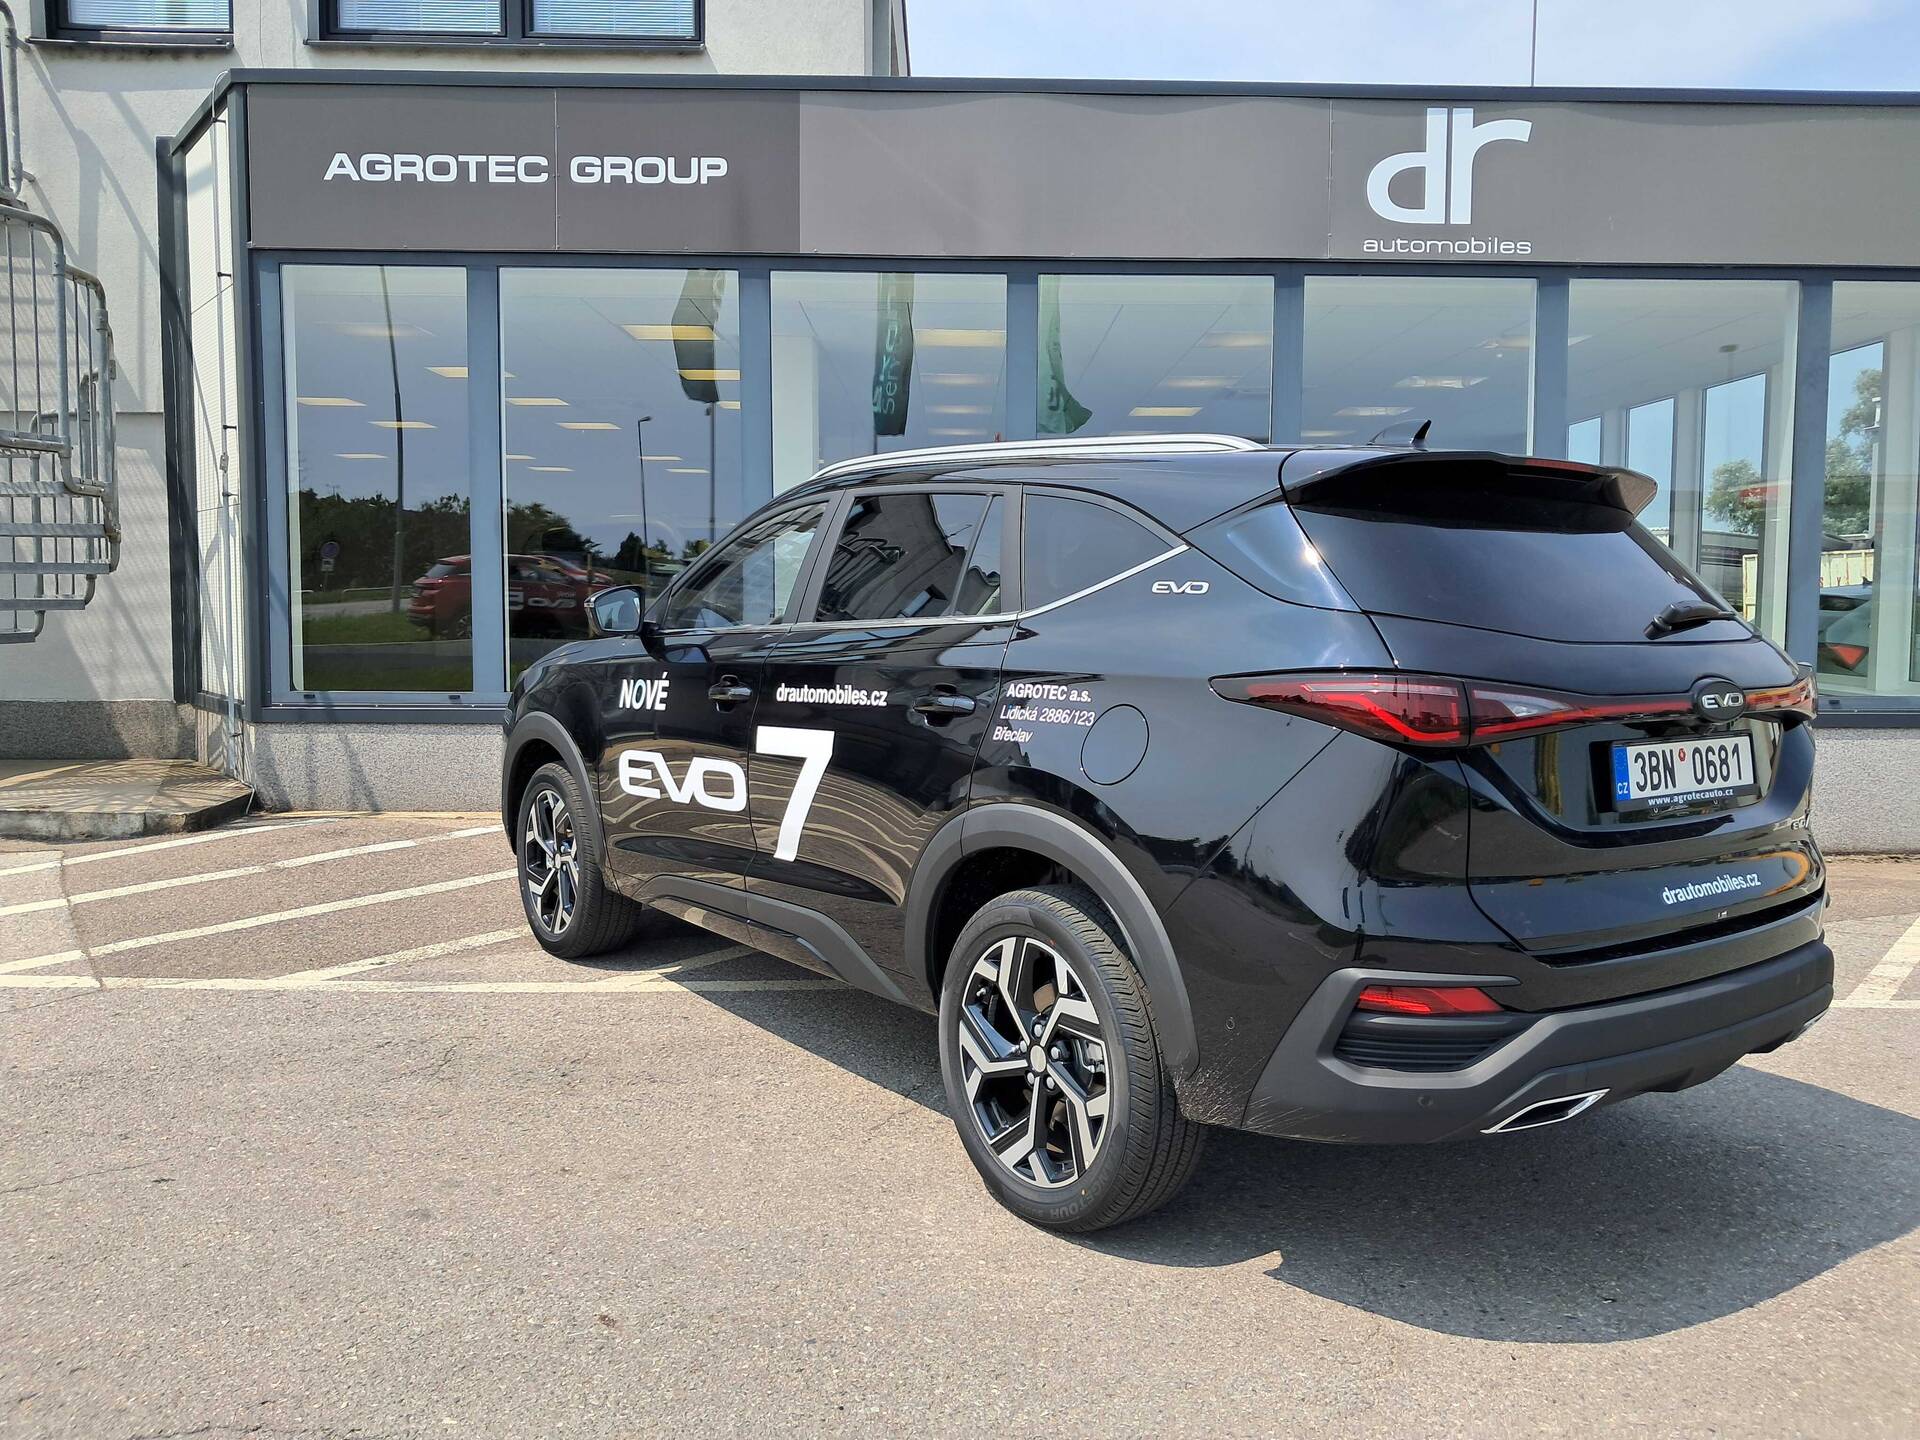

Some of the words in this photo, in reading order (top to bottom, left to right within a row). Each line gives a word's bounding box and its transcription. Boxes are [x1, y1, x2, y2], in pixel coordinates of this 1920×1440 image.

[323, 153, 549, 183] AGROTEC
[570, 156, 728, 184] GROUP
[1366, 107, 1533, 225] dr
[1363, 236, 1532, 255] automobiles
[1151, 580, 1210, 594] EVO
[618, 671, 670, 711] NOVÉ
[776, 683, 889, 707] drautomobiles.cz
[1006, 683, 1068, 701] AGROTEC
[1069, 690, 1092, 703] a.s.
[1701, 691, 1745, 709] EVO
[1000, 704, 1038, 722] Lidická
[1039, 707, 1096, 726] 2886/123
[992, 726, 1034, 743] Břeclav
[1634, 748, 1677, 793] 3BN
[1691, 742, 1742, 786] 0681
[618, 750, 748, 812] EVO
[756, 725, 836, 862] 7
[1616, 782, 1630, 795] CZ
[1648, 788, 1734, 807] www.agrotecauto.cz
[1662, 872, 1762, 905] drautomobiles.cz
